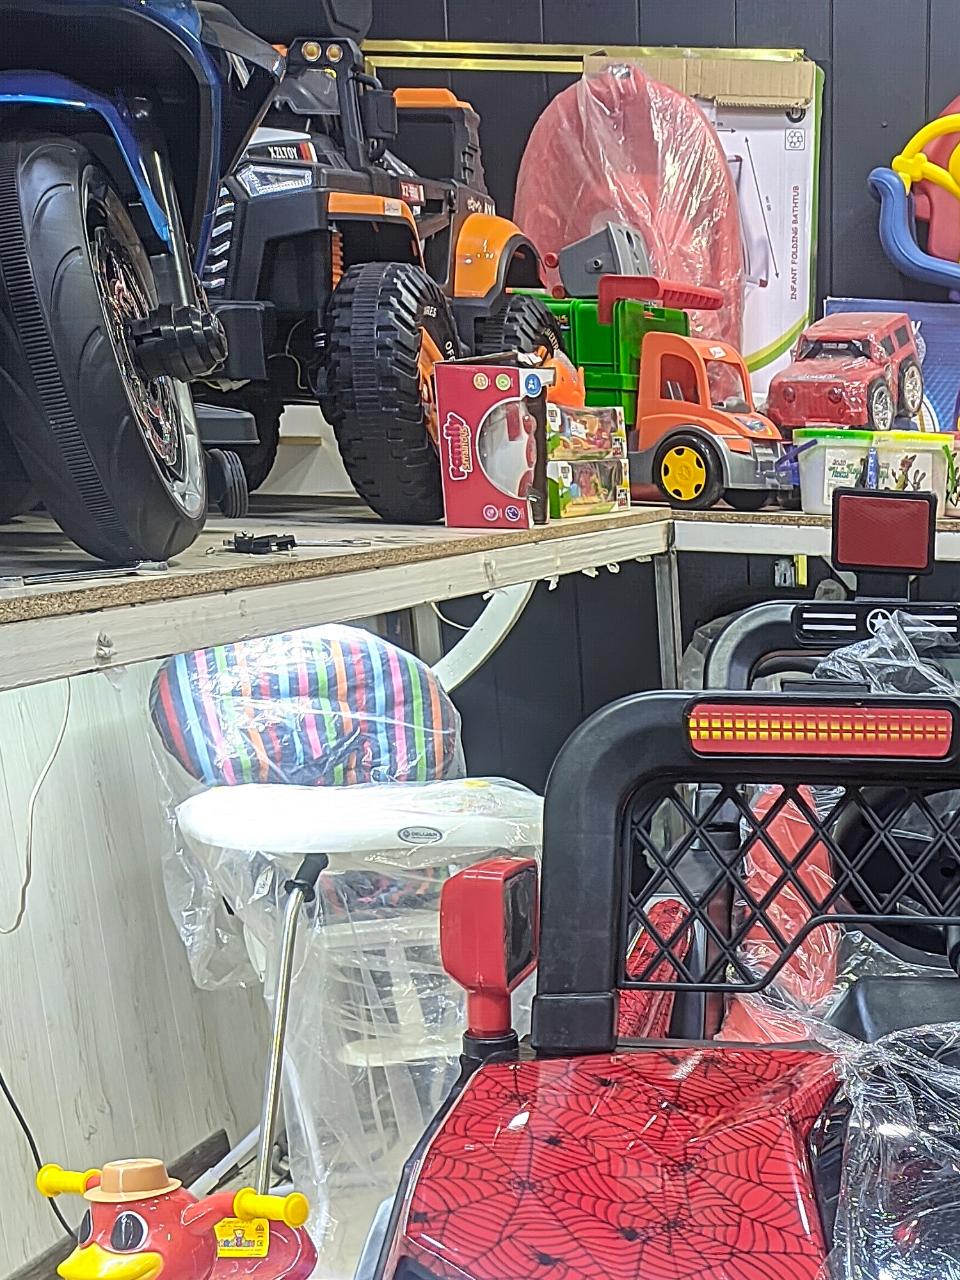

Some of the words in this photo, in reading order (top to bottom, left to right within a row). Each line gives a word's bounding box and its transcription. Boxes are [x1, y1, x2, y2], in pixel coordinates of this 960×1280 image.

[792, 185, 800, 225] BATHTUB
[791, 225, 799, 265] FOLDING
[790, 267, 798, 300] INFANT
